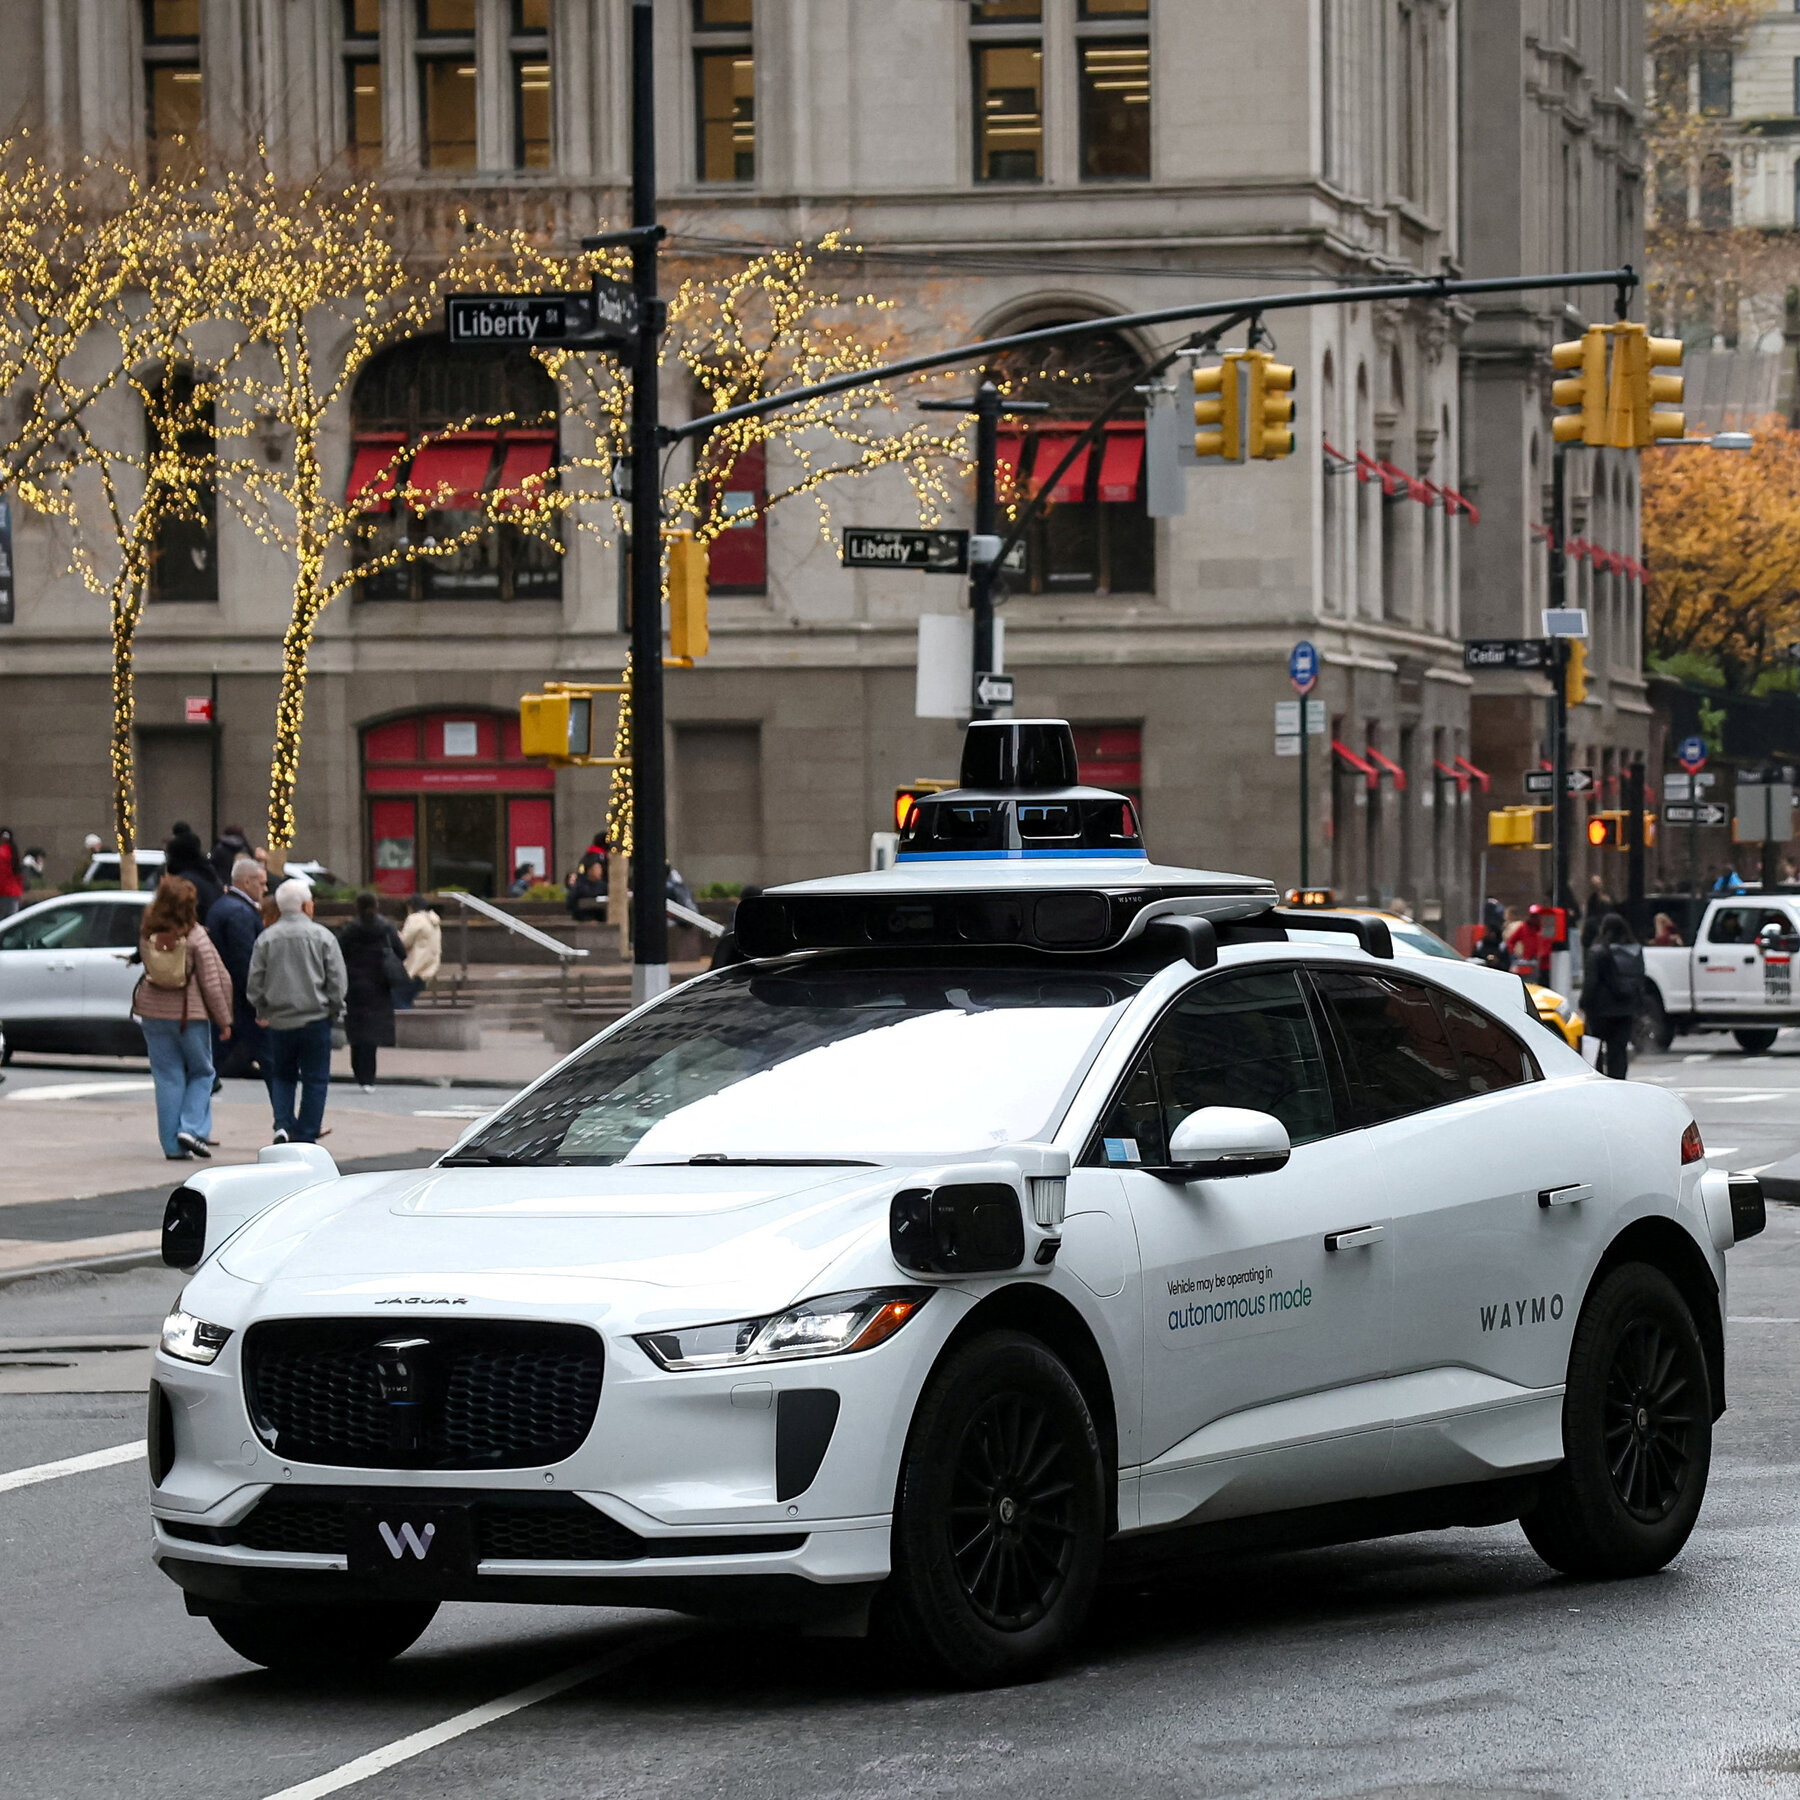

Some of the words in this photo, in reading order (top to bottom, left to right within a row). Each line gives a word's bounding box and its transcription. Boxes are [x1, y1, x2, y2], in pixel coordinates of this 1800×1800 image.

[458, 310, 540, 340] Liberty
[851, 538, 911, 564] Liberty
[1167, 1277, 1196, 1296] Vehicle
[1196, 1277, 1214, 1293] may
[1215, 1273, 1226, 1288] be
[1226, 1267, 1265, 1289] operating
[1265, 1265, 1273, 1280] in
[1168, 1295, 1266, 1331] autonomous
[1269, 1279, 1313, 1313] mode
[1480, 1293, 1564, 1332] WAYMO
